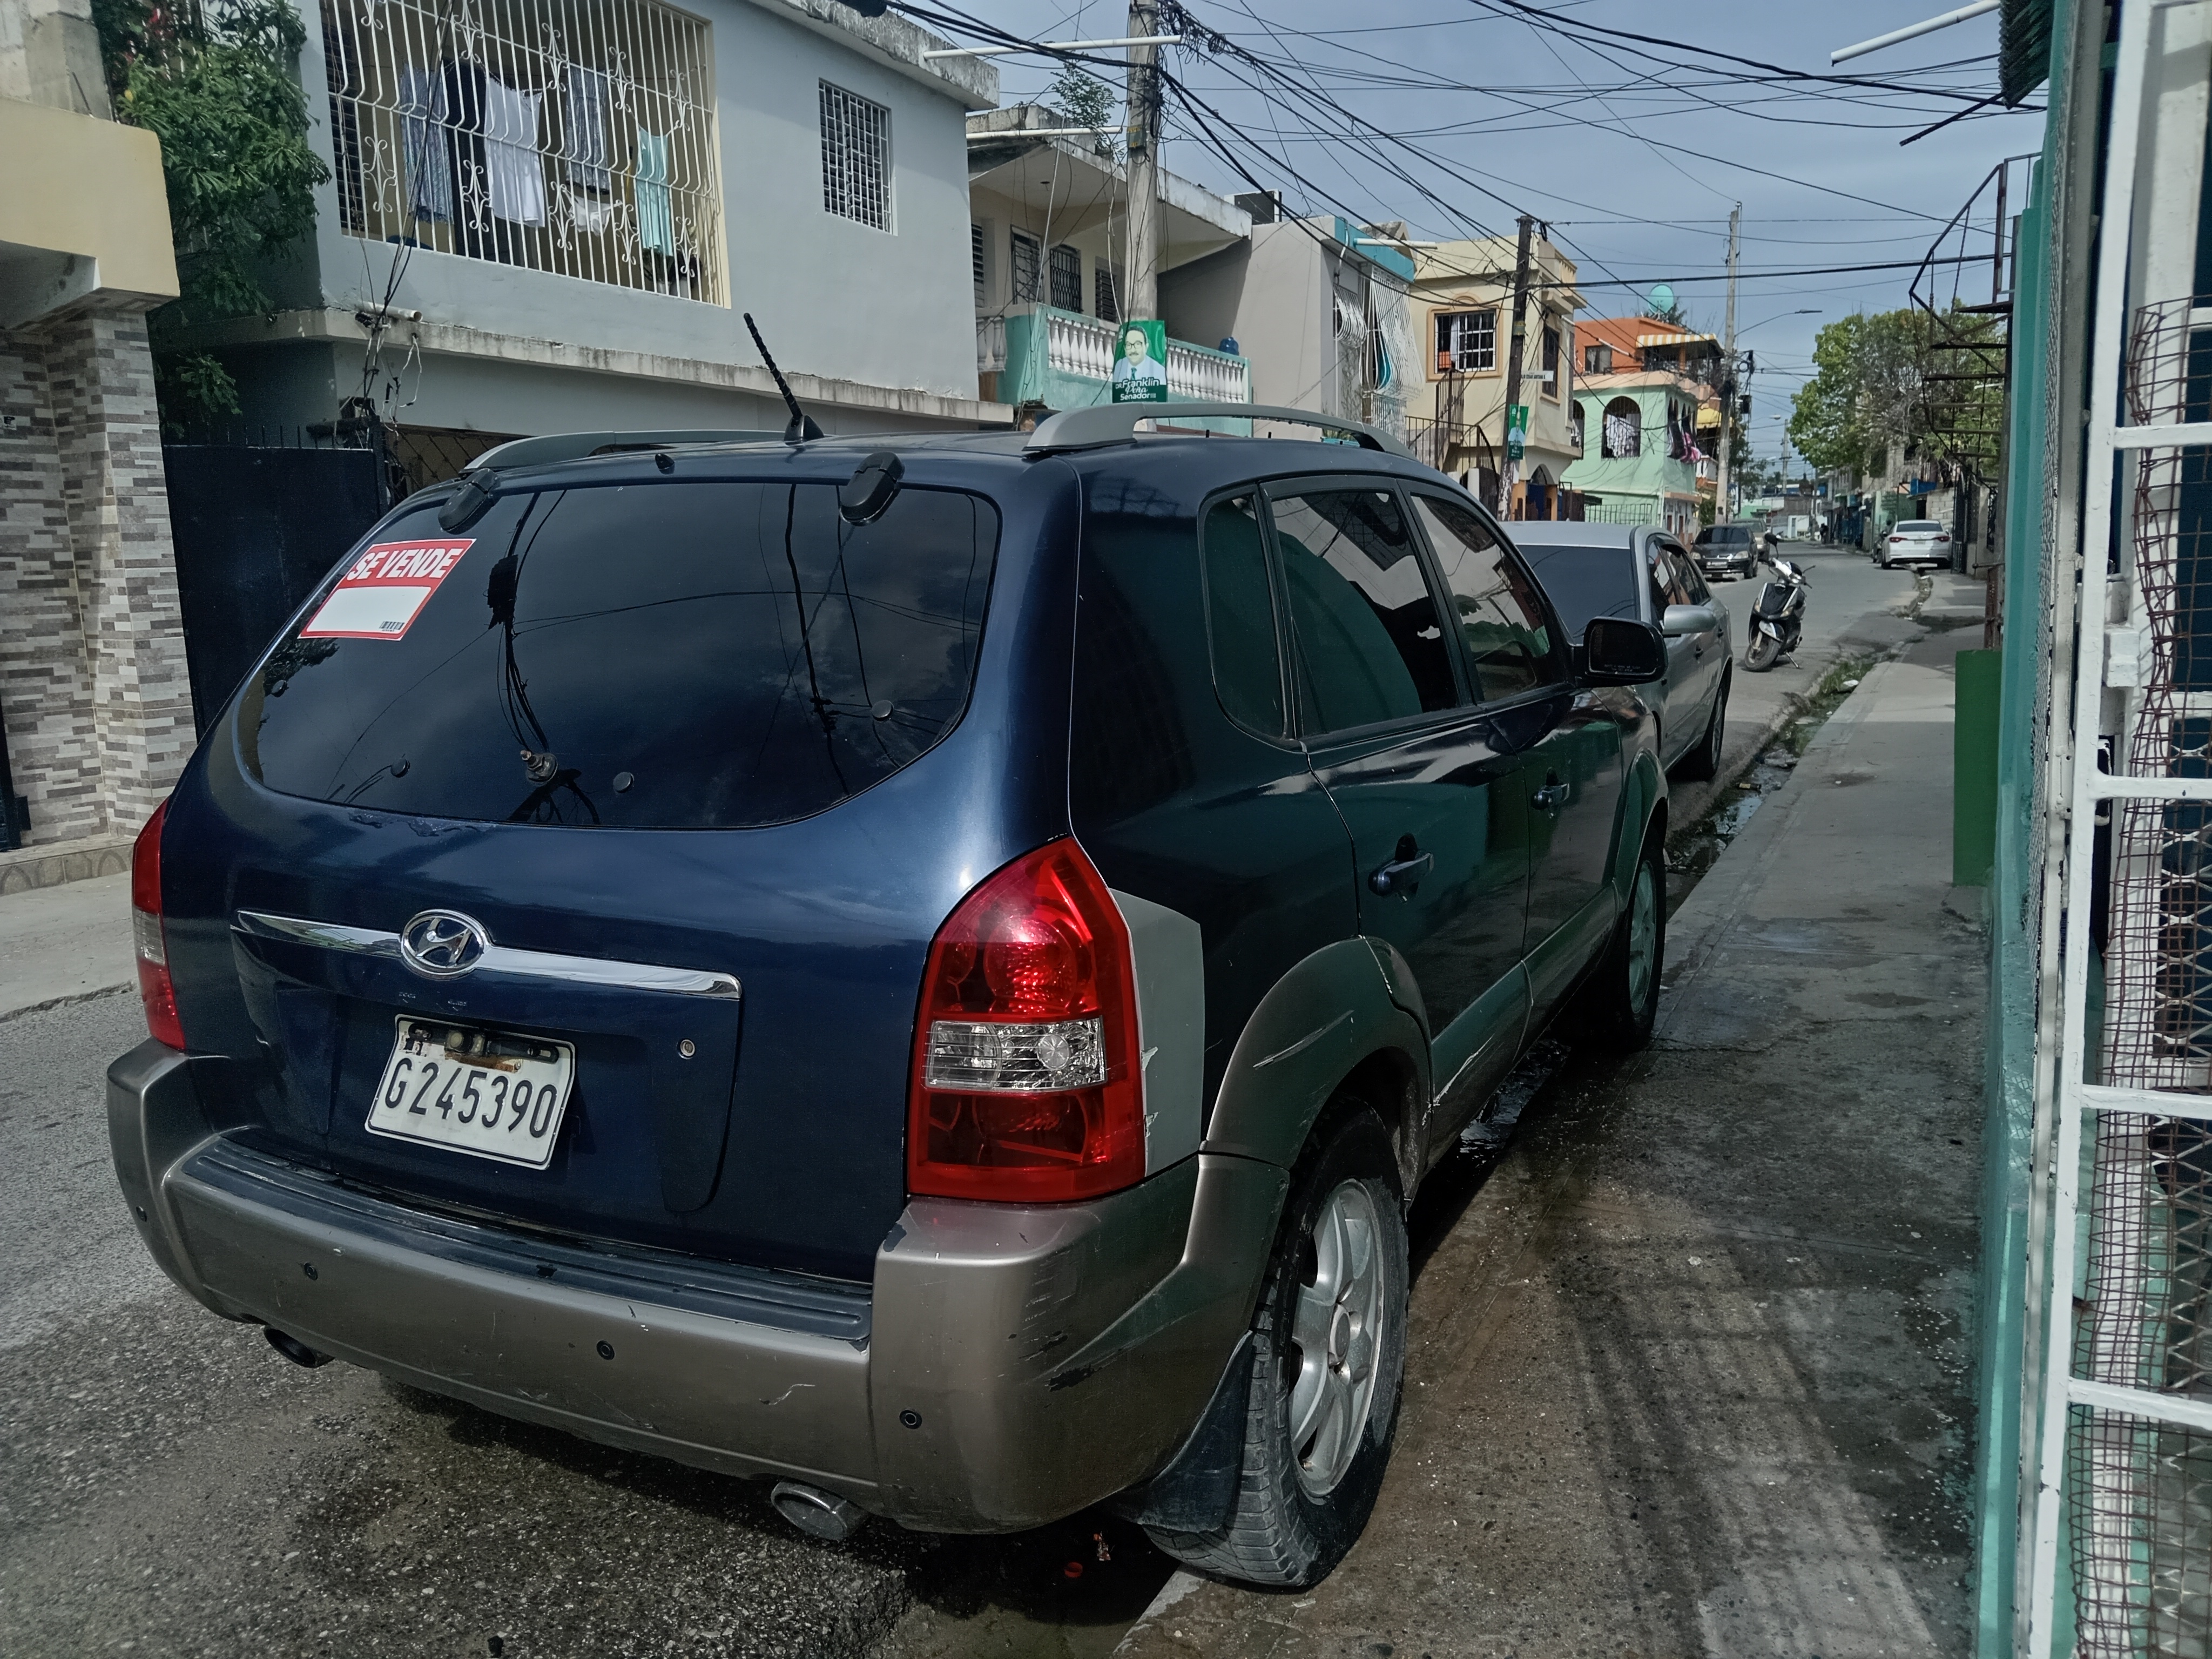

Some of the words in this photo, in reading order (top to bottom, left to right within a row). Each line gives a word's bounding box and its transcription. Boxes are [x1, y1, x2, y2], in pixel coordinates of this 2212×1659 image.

[1123, 378, 1159, 388] Franklin
[1125, 386, 1148, 394] Peña
[1120, 393, 1150, 401] Senador
[347, 551, 389, 581] SE
[376, 548, 464, 579] VENDE
[385, 1057, 557, 1138] G245390
